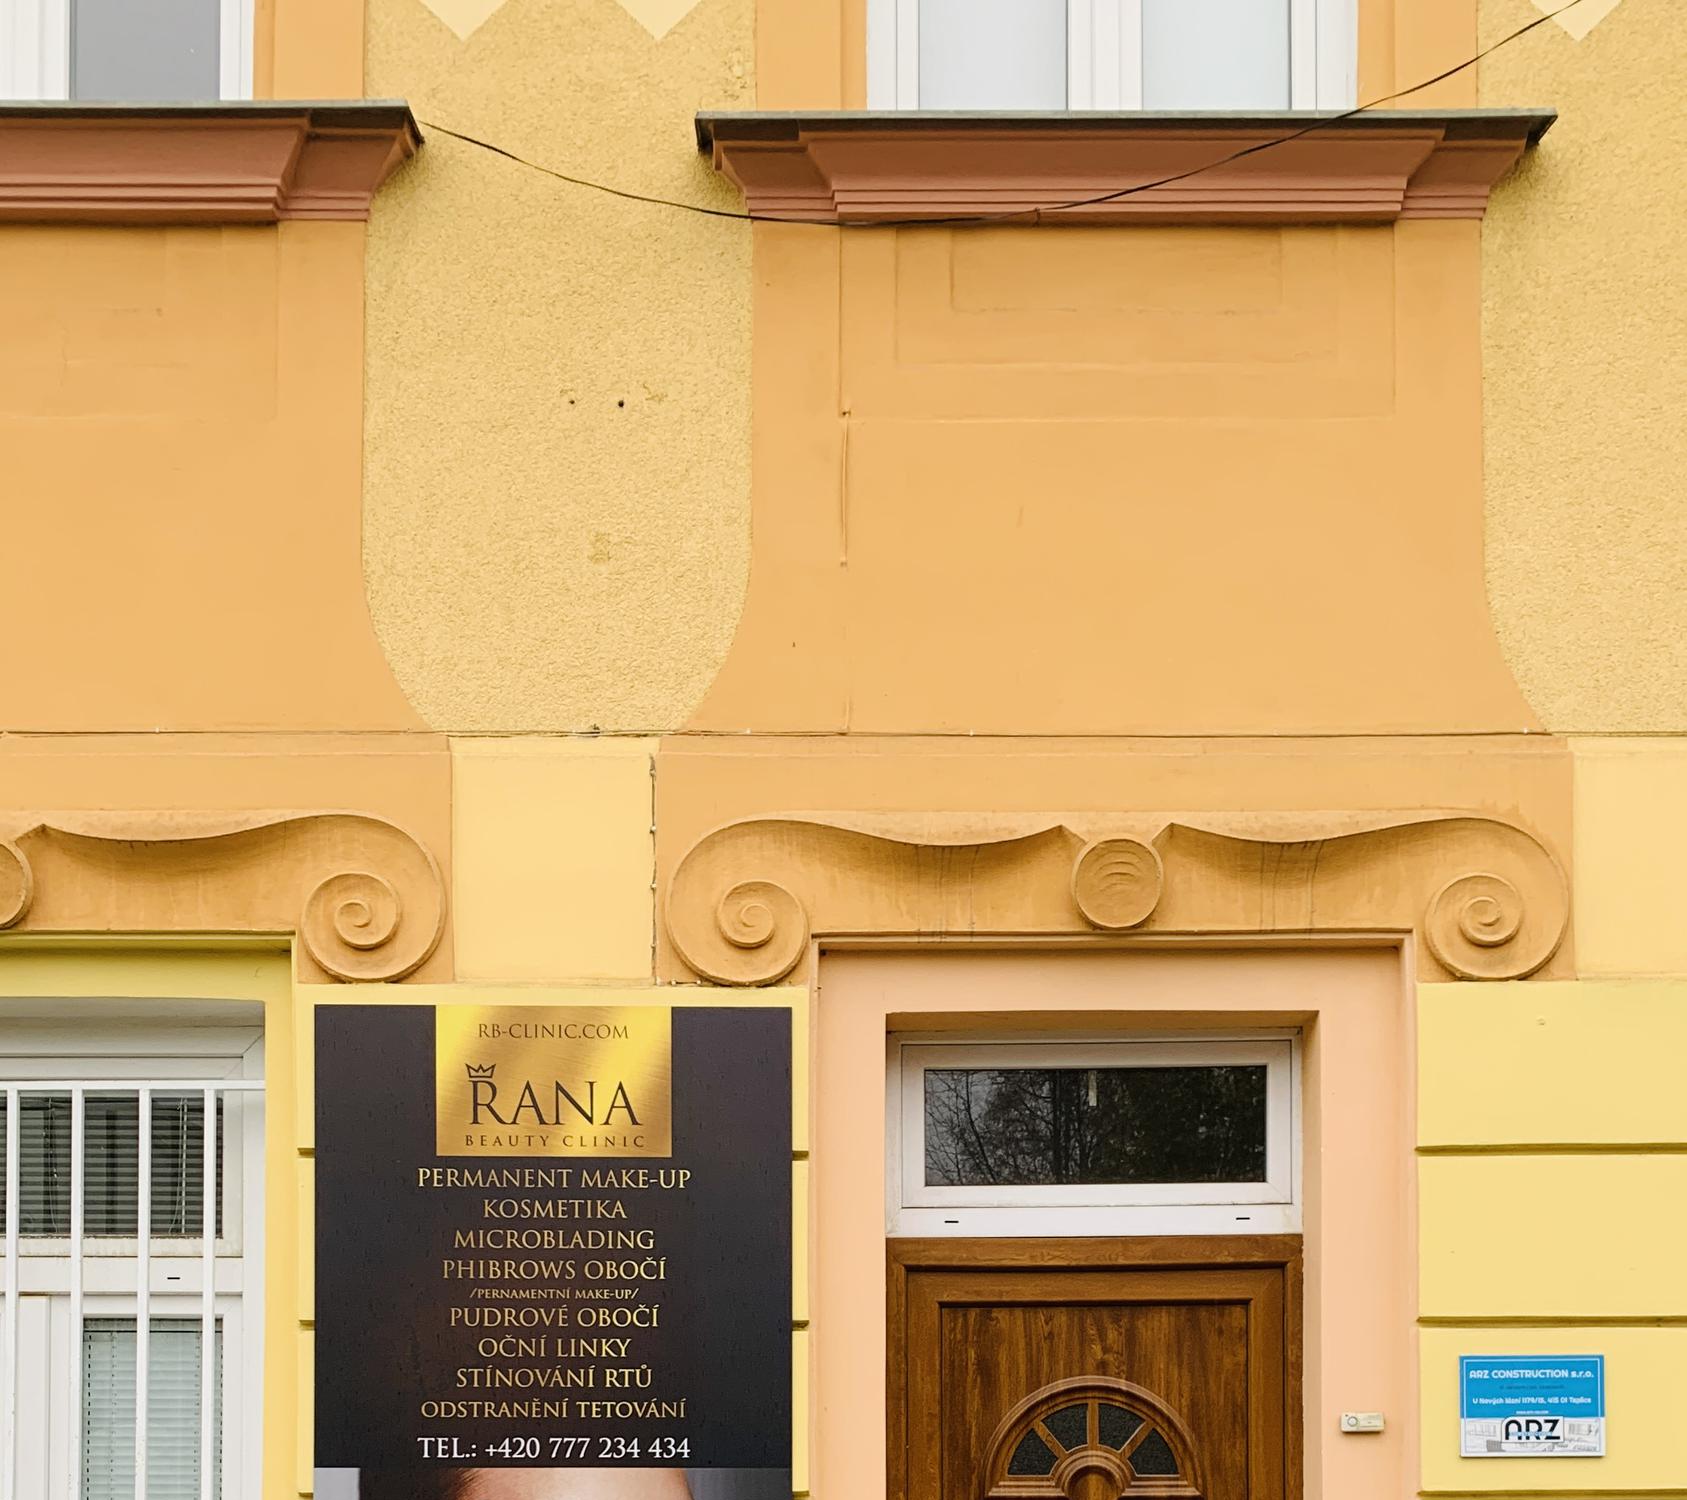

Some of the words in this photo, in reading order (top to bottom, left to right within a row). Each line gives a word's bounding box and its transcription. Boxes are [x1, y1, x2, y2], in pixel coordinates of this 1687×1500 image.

[477, 1023, 630, 1041] RB-CLINIC.COM
[470, 1079, 644, 1127] RANA
[465, 1135, 550, 1148] BEAUTY
[562, 1135, 646, 1148] CLINIC
[417, 1168, 573, 1189] PERMANENT
[580, 1168, 692, 1189] MAKE-UP
[483, 1199, 628, 1219] KOSMETIKA
[454, 1229, 655, 1249] MICROBLADING
[442, 1260, 576, 1280] PHIBROWS
[584, 1257, 667, 1280] OBOČÍ
[469, 1286, 570, 1300] /PERNAMENTNÍ
[575, 1287, 640, 1300] MAKE-UP/
[450, 1304, 569, 1327] PUDROVÉ
[576, 1304, 659, 1328] OBOČÍ
[478, 1334, 546, 1358] OČNÍ
[556, 1338, 632, 1357] LINKY
[456, 1365, 596, 1388] STÍNOVÁNÍ
[604, 1364, 652, 1388] RTŮ
[1469, 1369, 1490, 1379] ARZ
[1491, 1369, 1569, 1379] CONSTRUCTION
[1570, 1370, 1595, 1379] s.r.o.
[421, 1397, 568, 1418] ODSTRANĚNÍ
[575, 1398, 687, 1418] TETOVÁNÍ
[1504, 1419, 1561, 1441] ARZ
[416, 1437, 477, 1458] TEL.:
[484, 1437, 540, 1459] +420
[548, 1437, 591, 1459] 777
[598, 1437, 641, 1459] 234
[647, 1437, 691, 1459] 434
